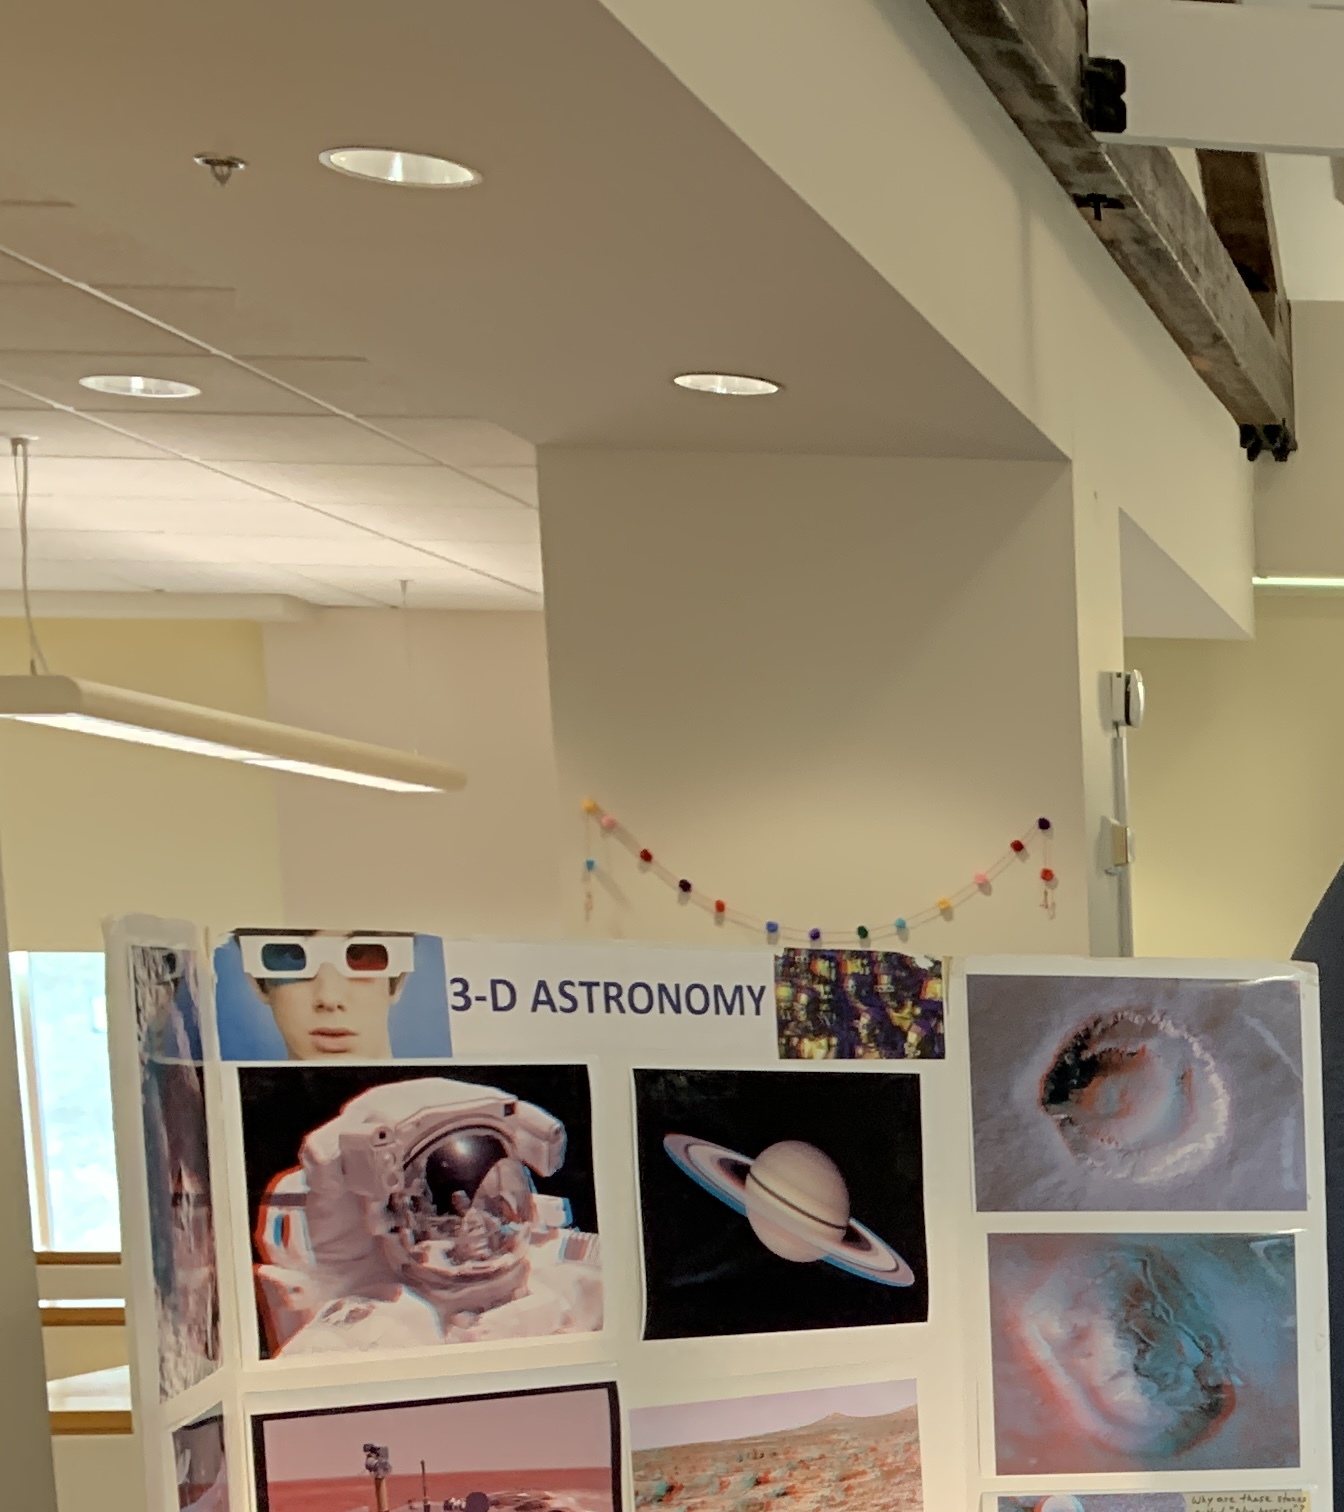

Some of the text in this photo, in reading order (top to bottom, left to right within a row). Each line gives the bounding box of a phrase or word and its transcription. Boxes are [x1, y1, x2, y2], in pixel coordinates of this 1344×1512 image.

[450, 977, 766, 1016] 3-D ASTRONOMY
[1191, 1494, 1213, 1507] Why
